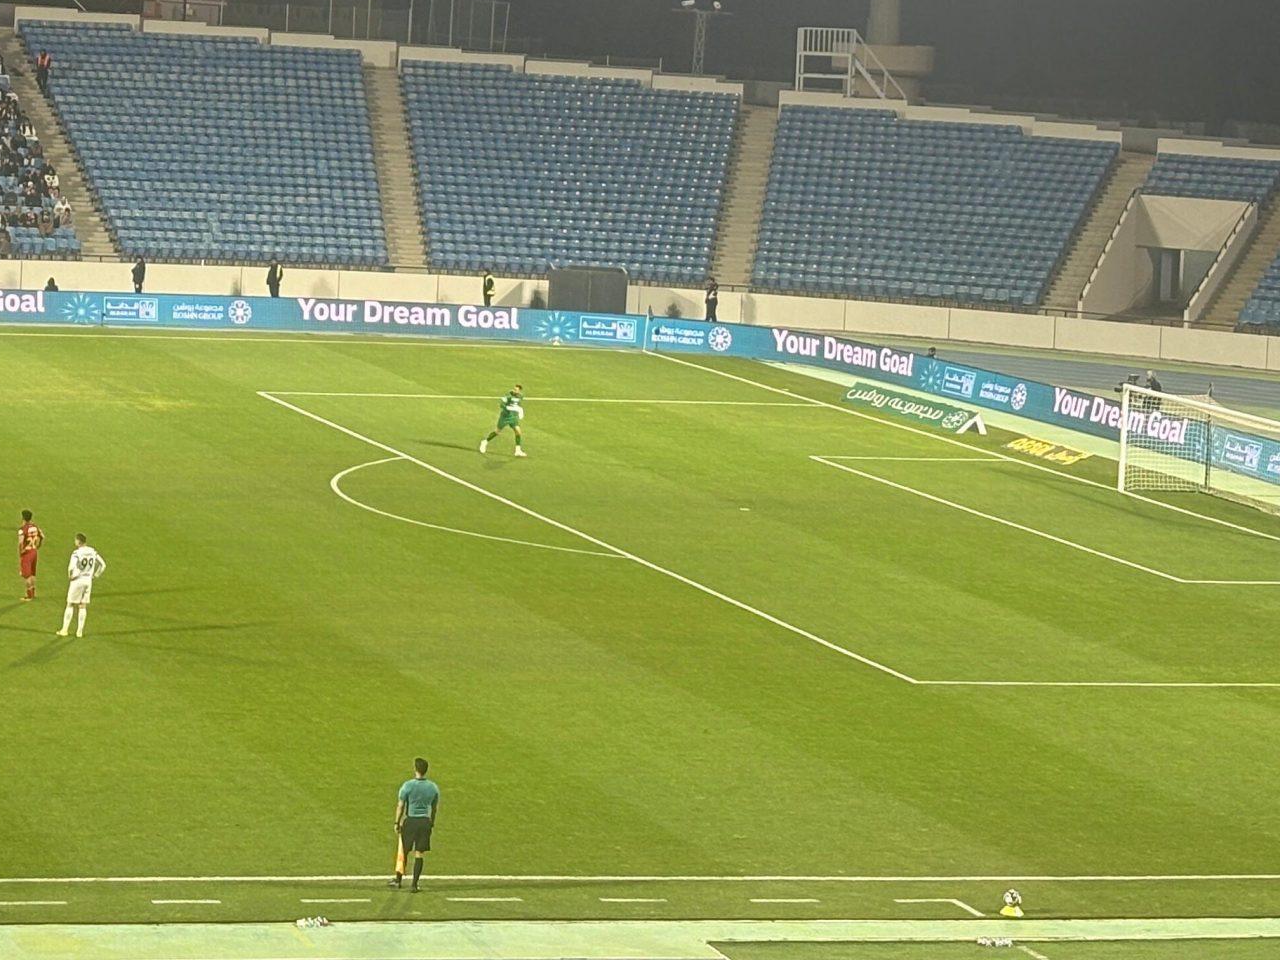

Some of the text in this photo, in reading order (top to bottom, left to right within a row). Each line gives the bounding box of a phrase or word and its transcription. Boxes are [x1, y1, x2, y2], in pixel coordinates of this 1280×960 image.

[297, 298, 519, 330] Your Dream Goal
[772, 328, 914, 377] Your Dream Goal
[1054, 387, 1090, 419] Your
[1147, 409, 1189, 444] Goal
